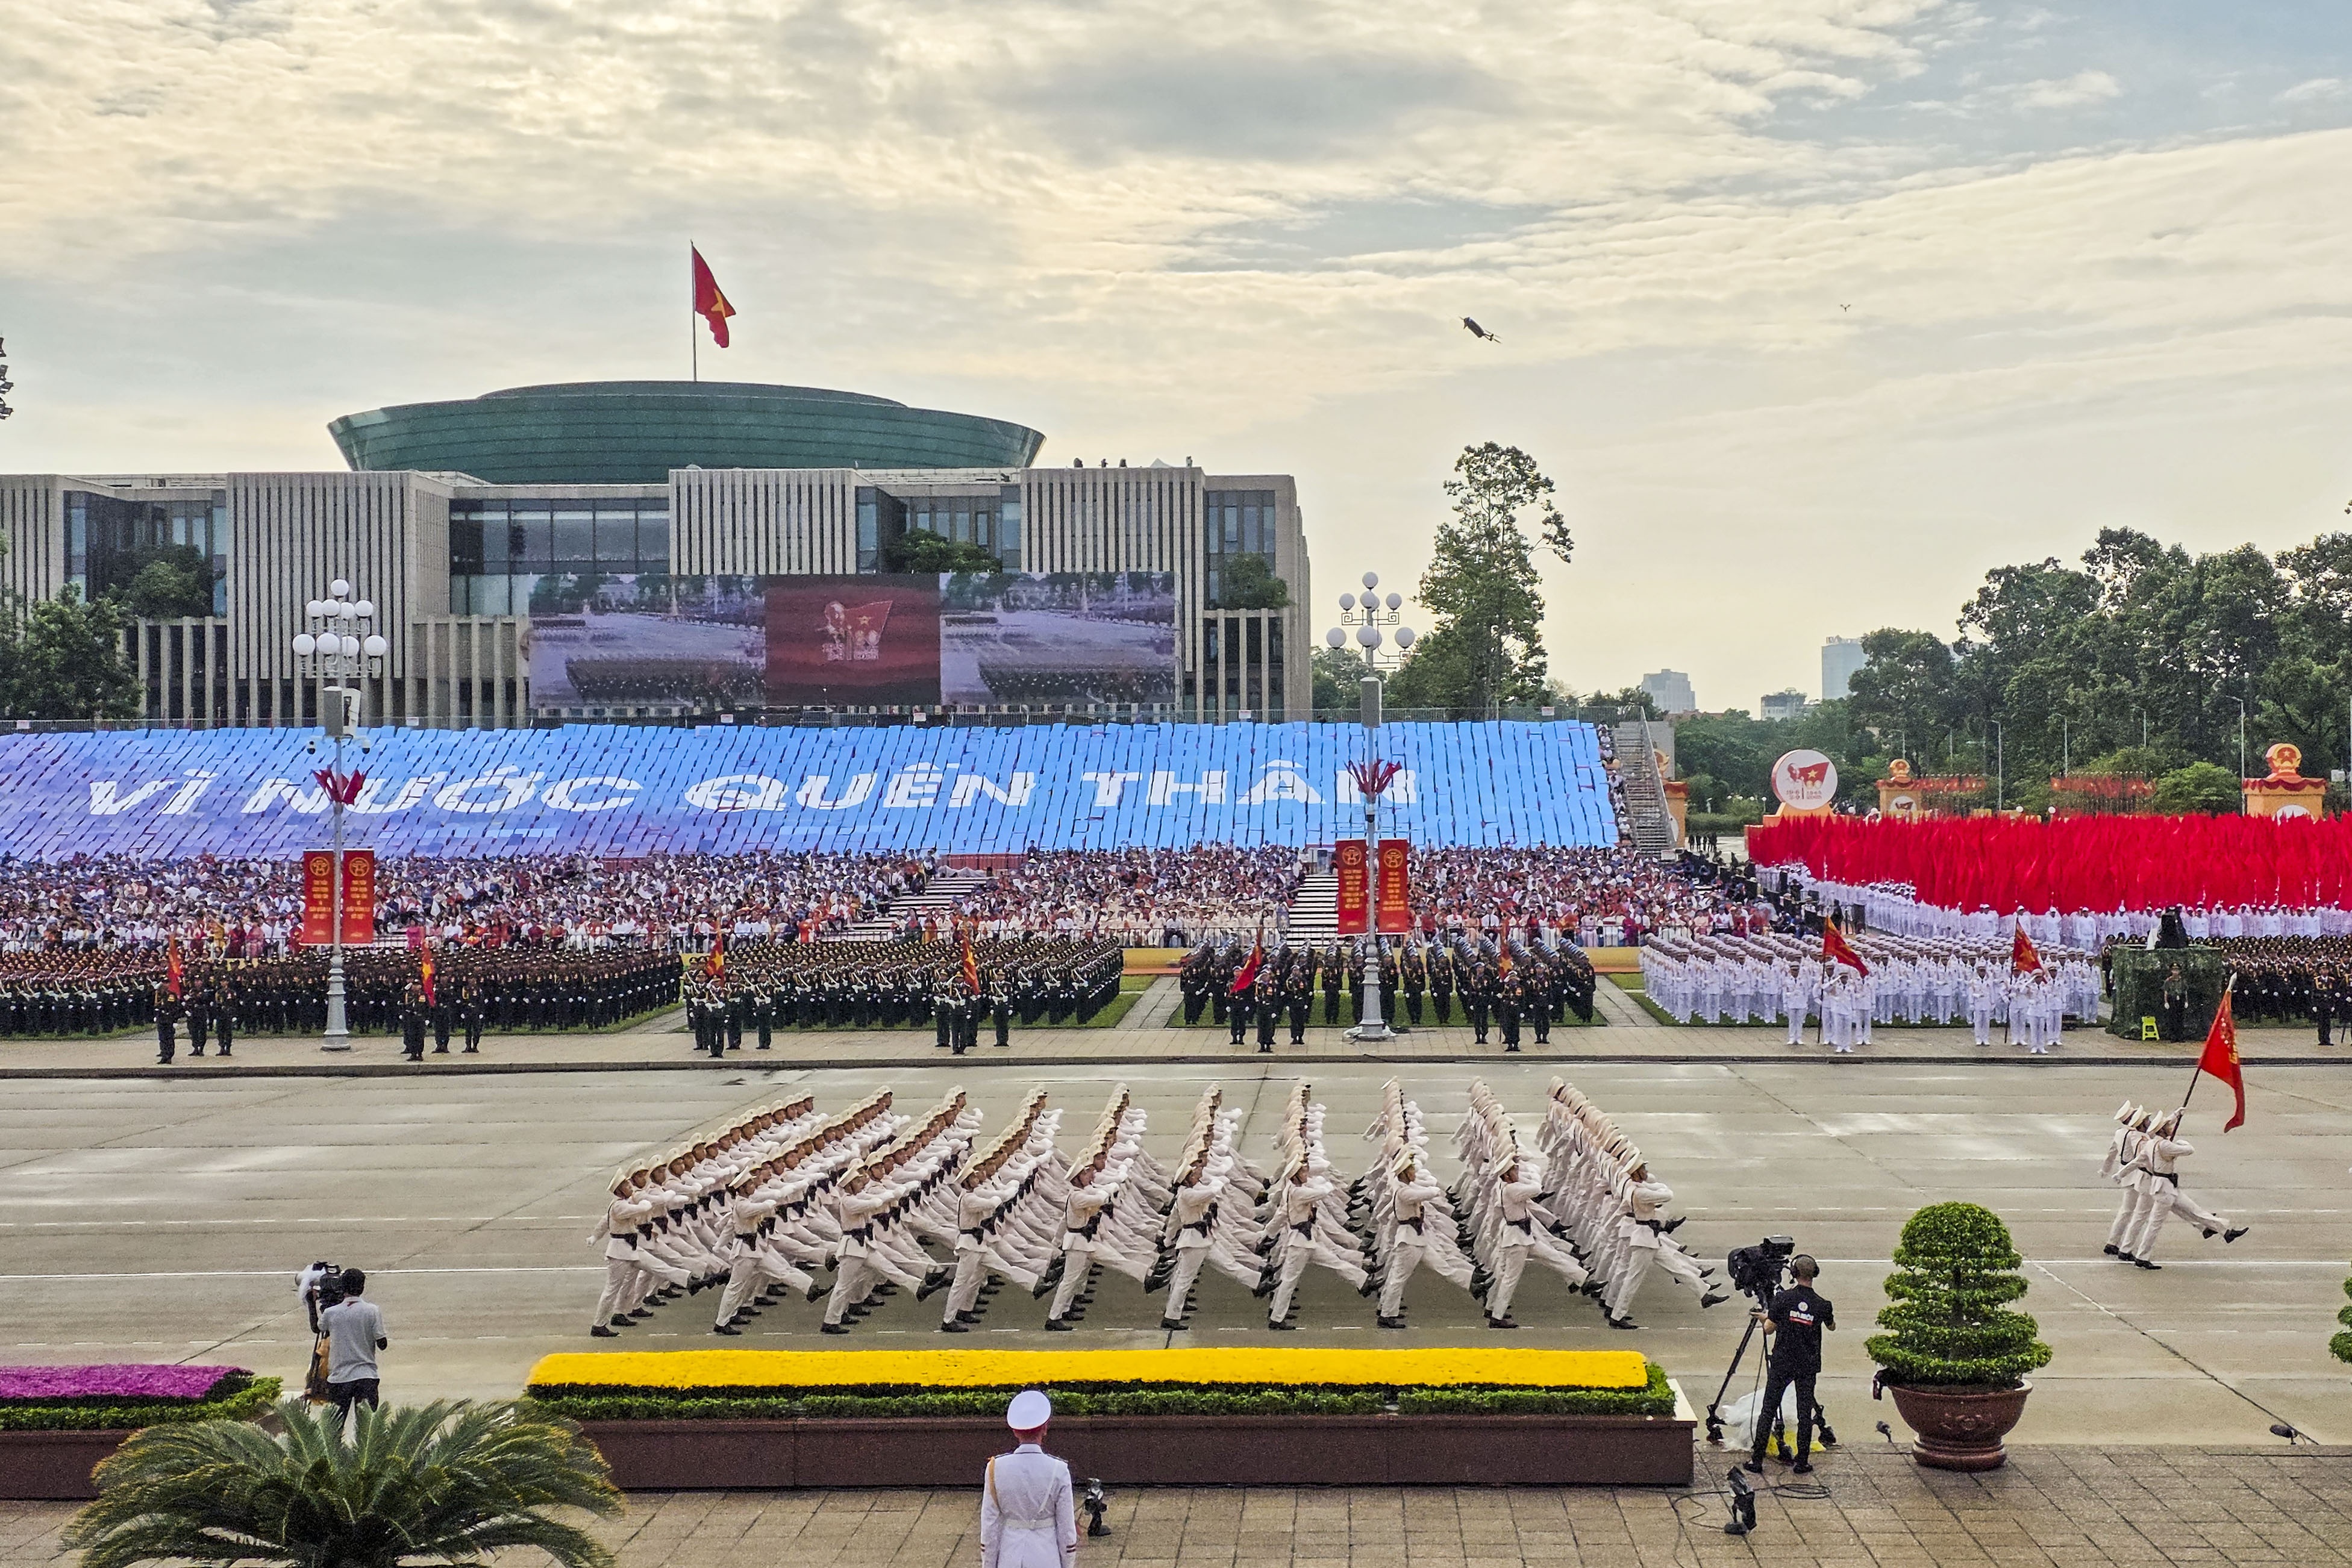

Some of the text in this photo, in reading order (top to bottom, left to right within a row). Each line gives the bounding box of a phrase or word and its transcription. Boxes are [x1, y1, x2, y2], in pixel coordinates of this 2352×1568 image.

[90, 759, 1417, 815] VÌ NƯỚC QUÊN THÂN
